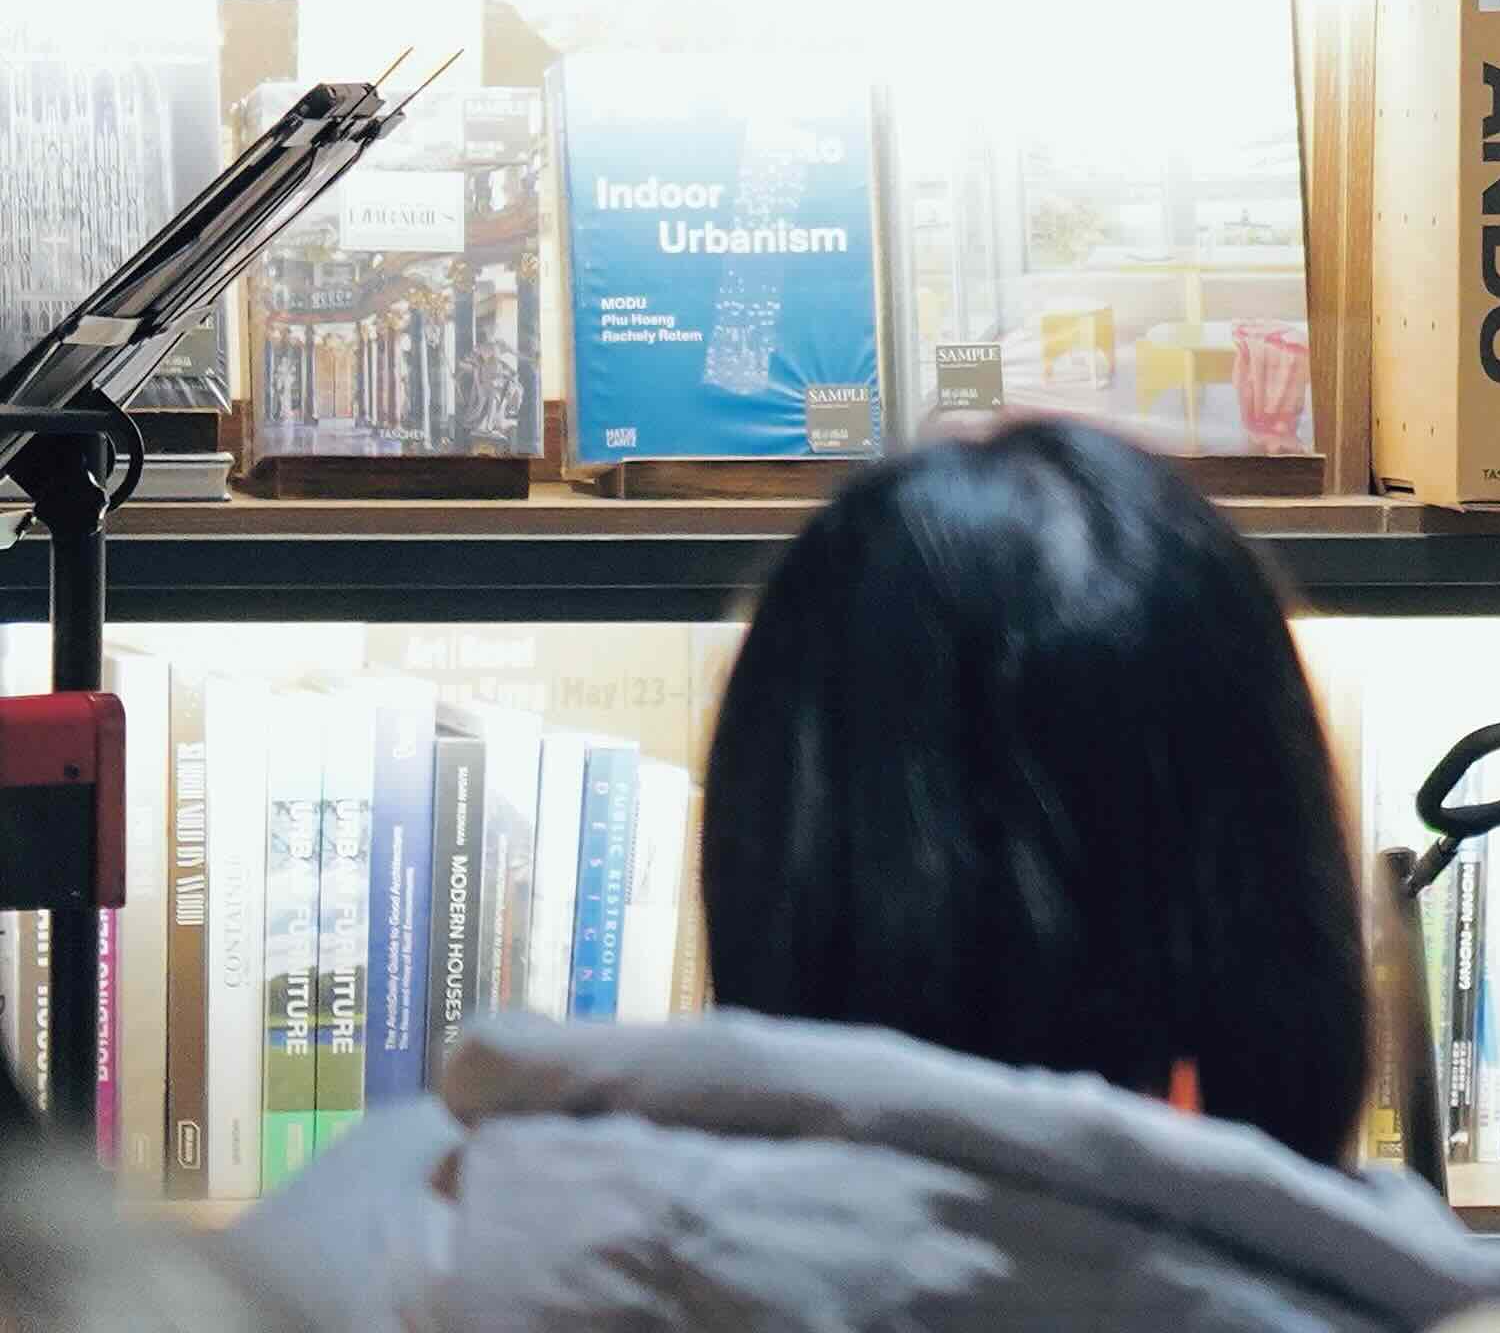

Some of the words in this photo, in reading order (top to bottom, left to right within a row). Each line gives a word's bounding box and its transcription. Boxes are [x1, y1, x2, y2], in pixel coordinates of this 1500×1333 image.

[599, 176, 722, 210] Indoor
[659, 221, 846, 256] Urbanism
[808, 388, 867, 403] SAMPLE
[448, 854, 468, 942] MODERN
[443, 944, 465, 1023] HOUSES
